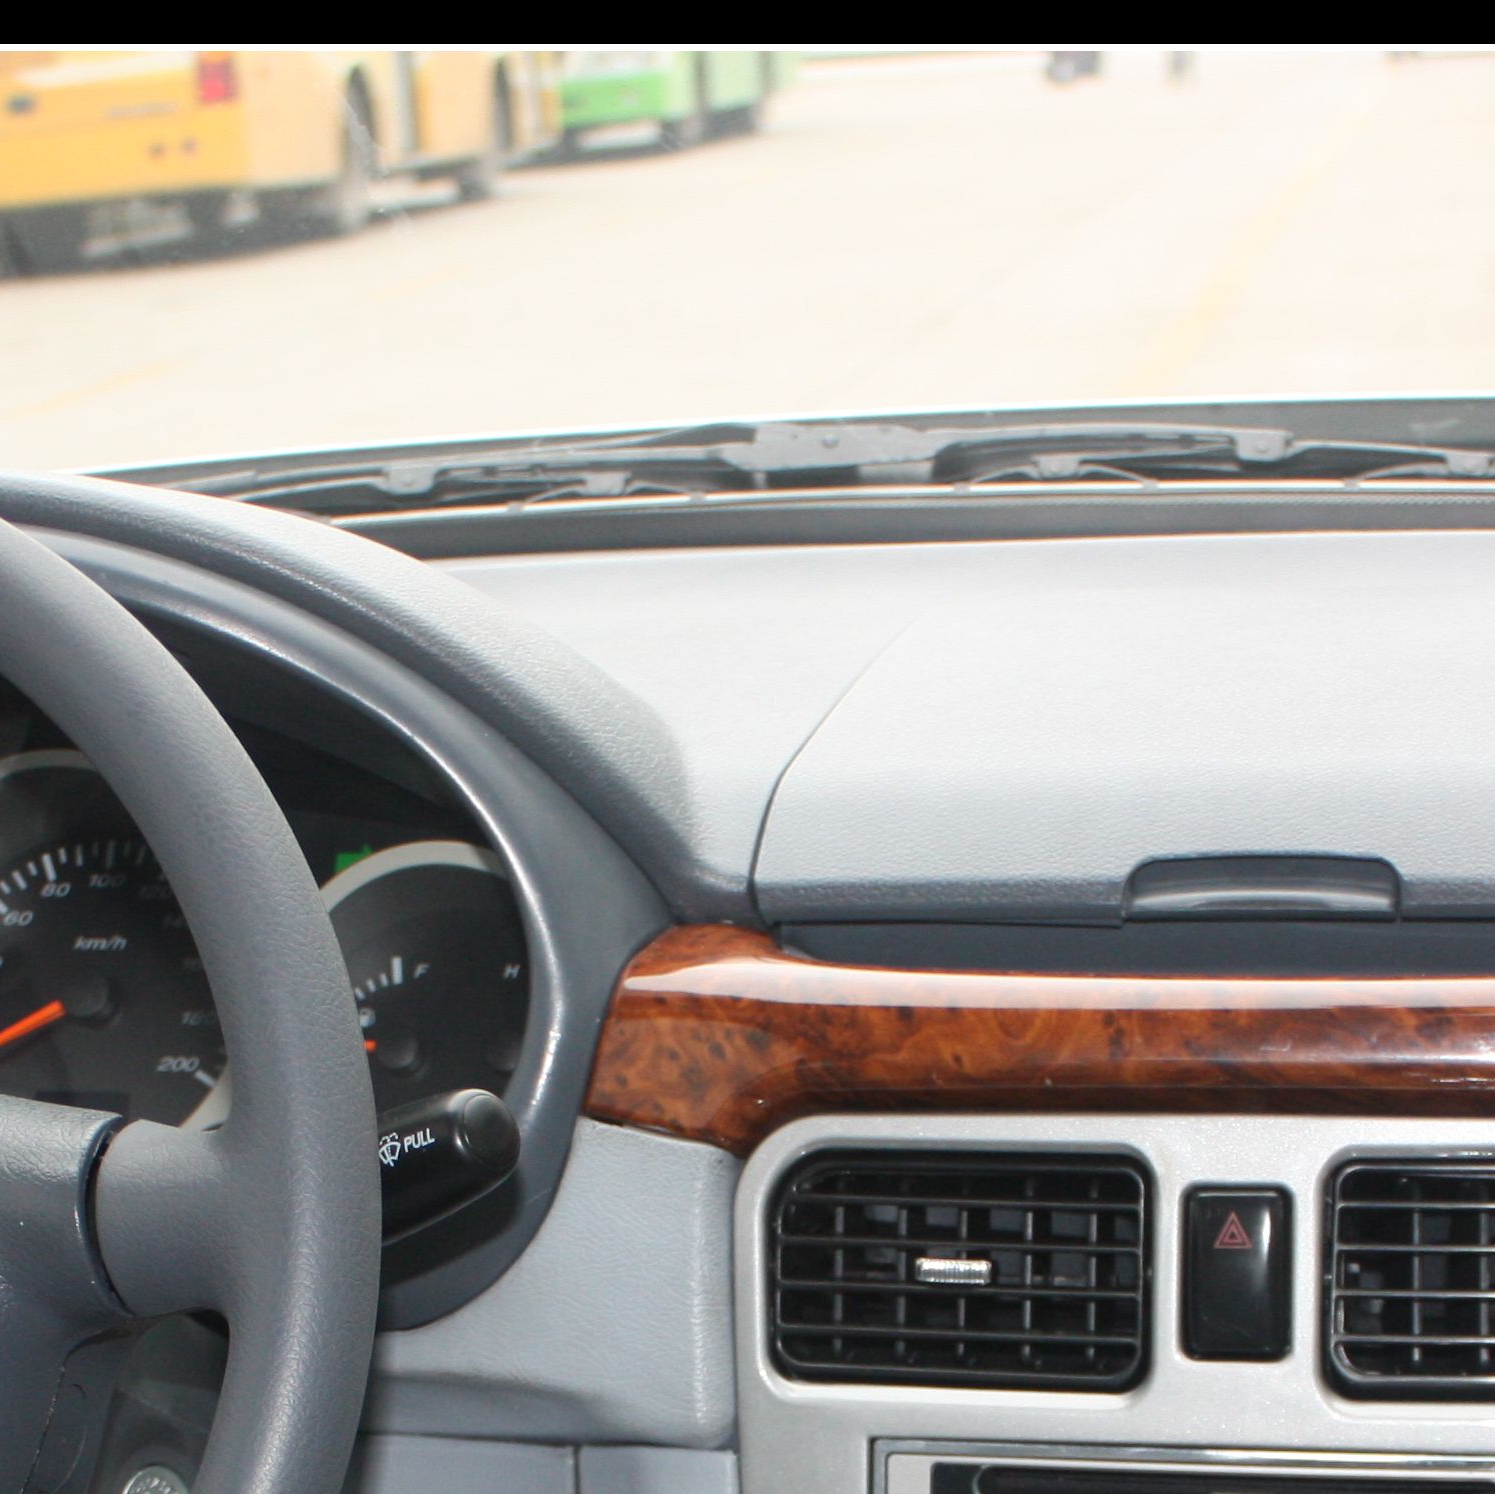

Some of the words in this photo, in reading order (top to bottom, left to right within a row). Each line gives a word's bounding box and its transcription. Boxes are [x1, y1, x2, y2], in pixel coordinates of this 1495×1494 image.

[41, 883, 71, 897] 80
[4, 912, 33, 926] 60
[73, 936, 127, 951] km/h
[414, 965, 429, 978] F
[505, 965, 520, 978] H
[157, 1056, 199, 1072] 200
[404, 1128, 435, 1152] PULL
